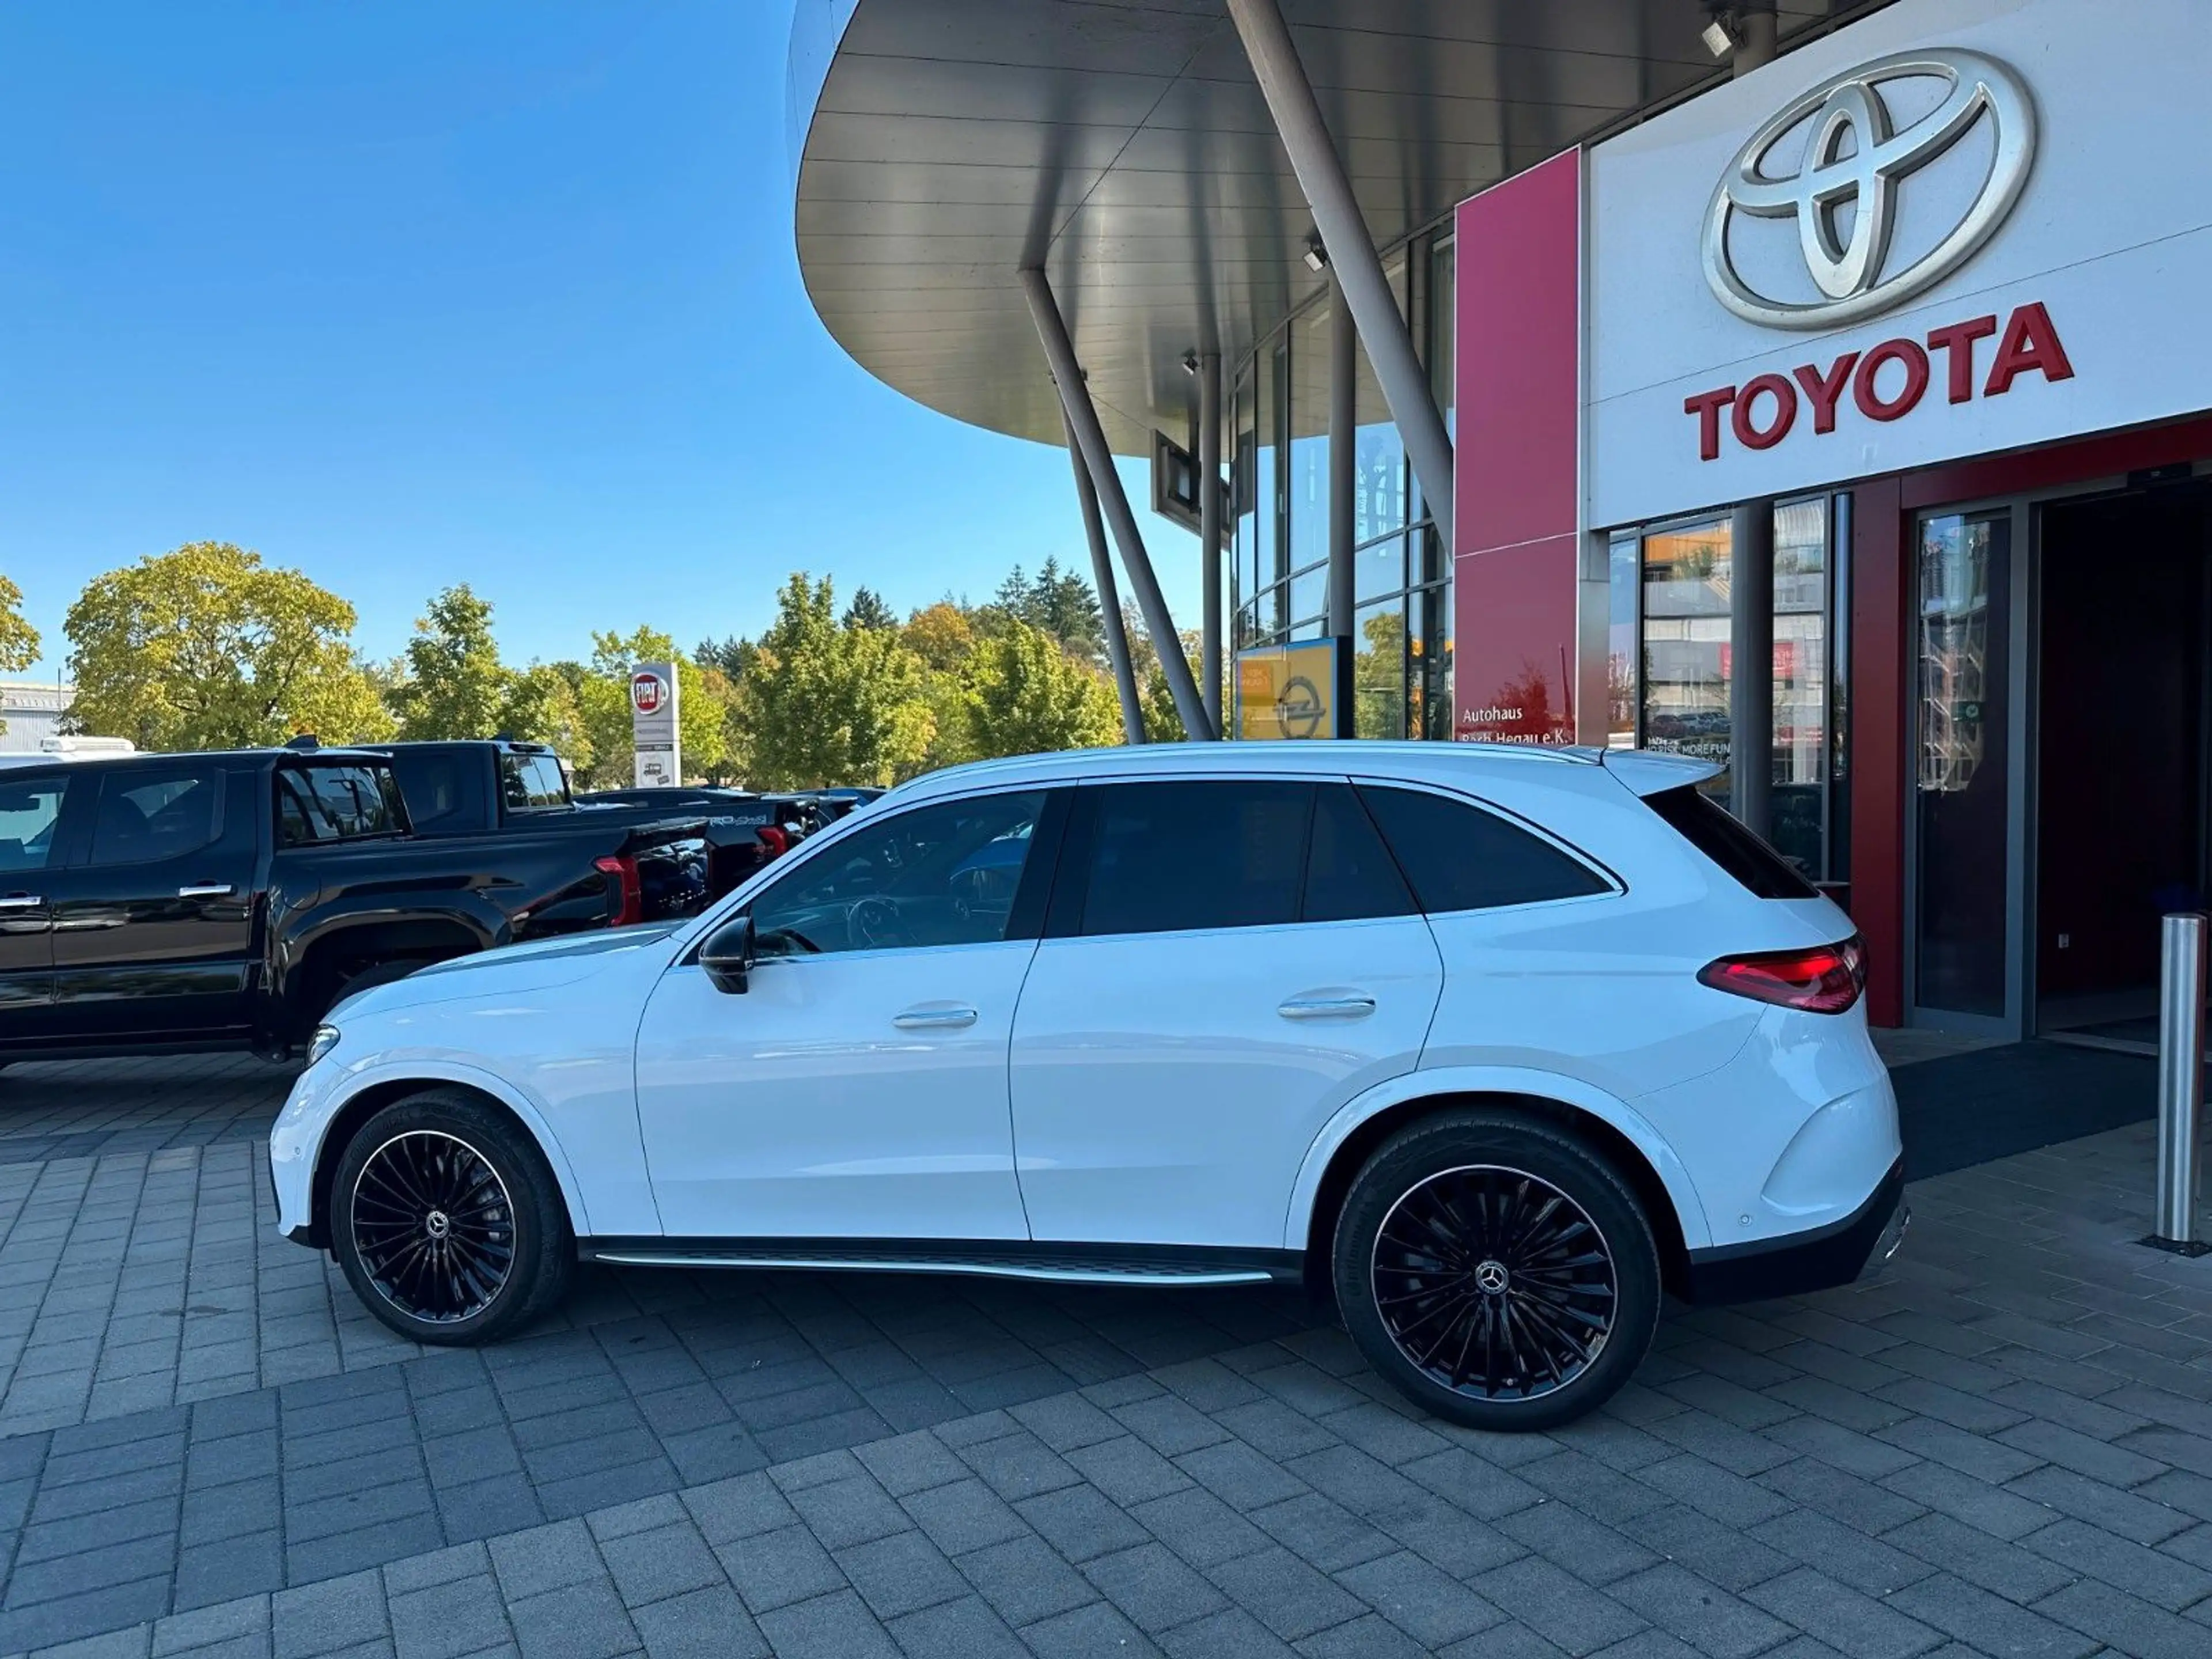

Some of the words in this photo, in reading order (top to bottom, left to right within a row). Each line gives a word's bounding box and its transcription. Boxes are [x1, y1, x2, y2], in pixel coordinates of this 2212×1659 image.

[1684, 301, 2075, 461] TOYOTA
[636, 682, 657, 704] FIAT
[1463, 706, 1523, 723] Autohaus
[1543, 728, 1568, 745] e.K.
[1683, 744, 1709, 755] MORE
[1710, 743, 1730, 754] FUN
